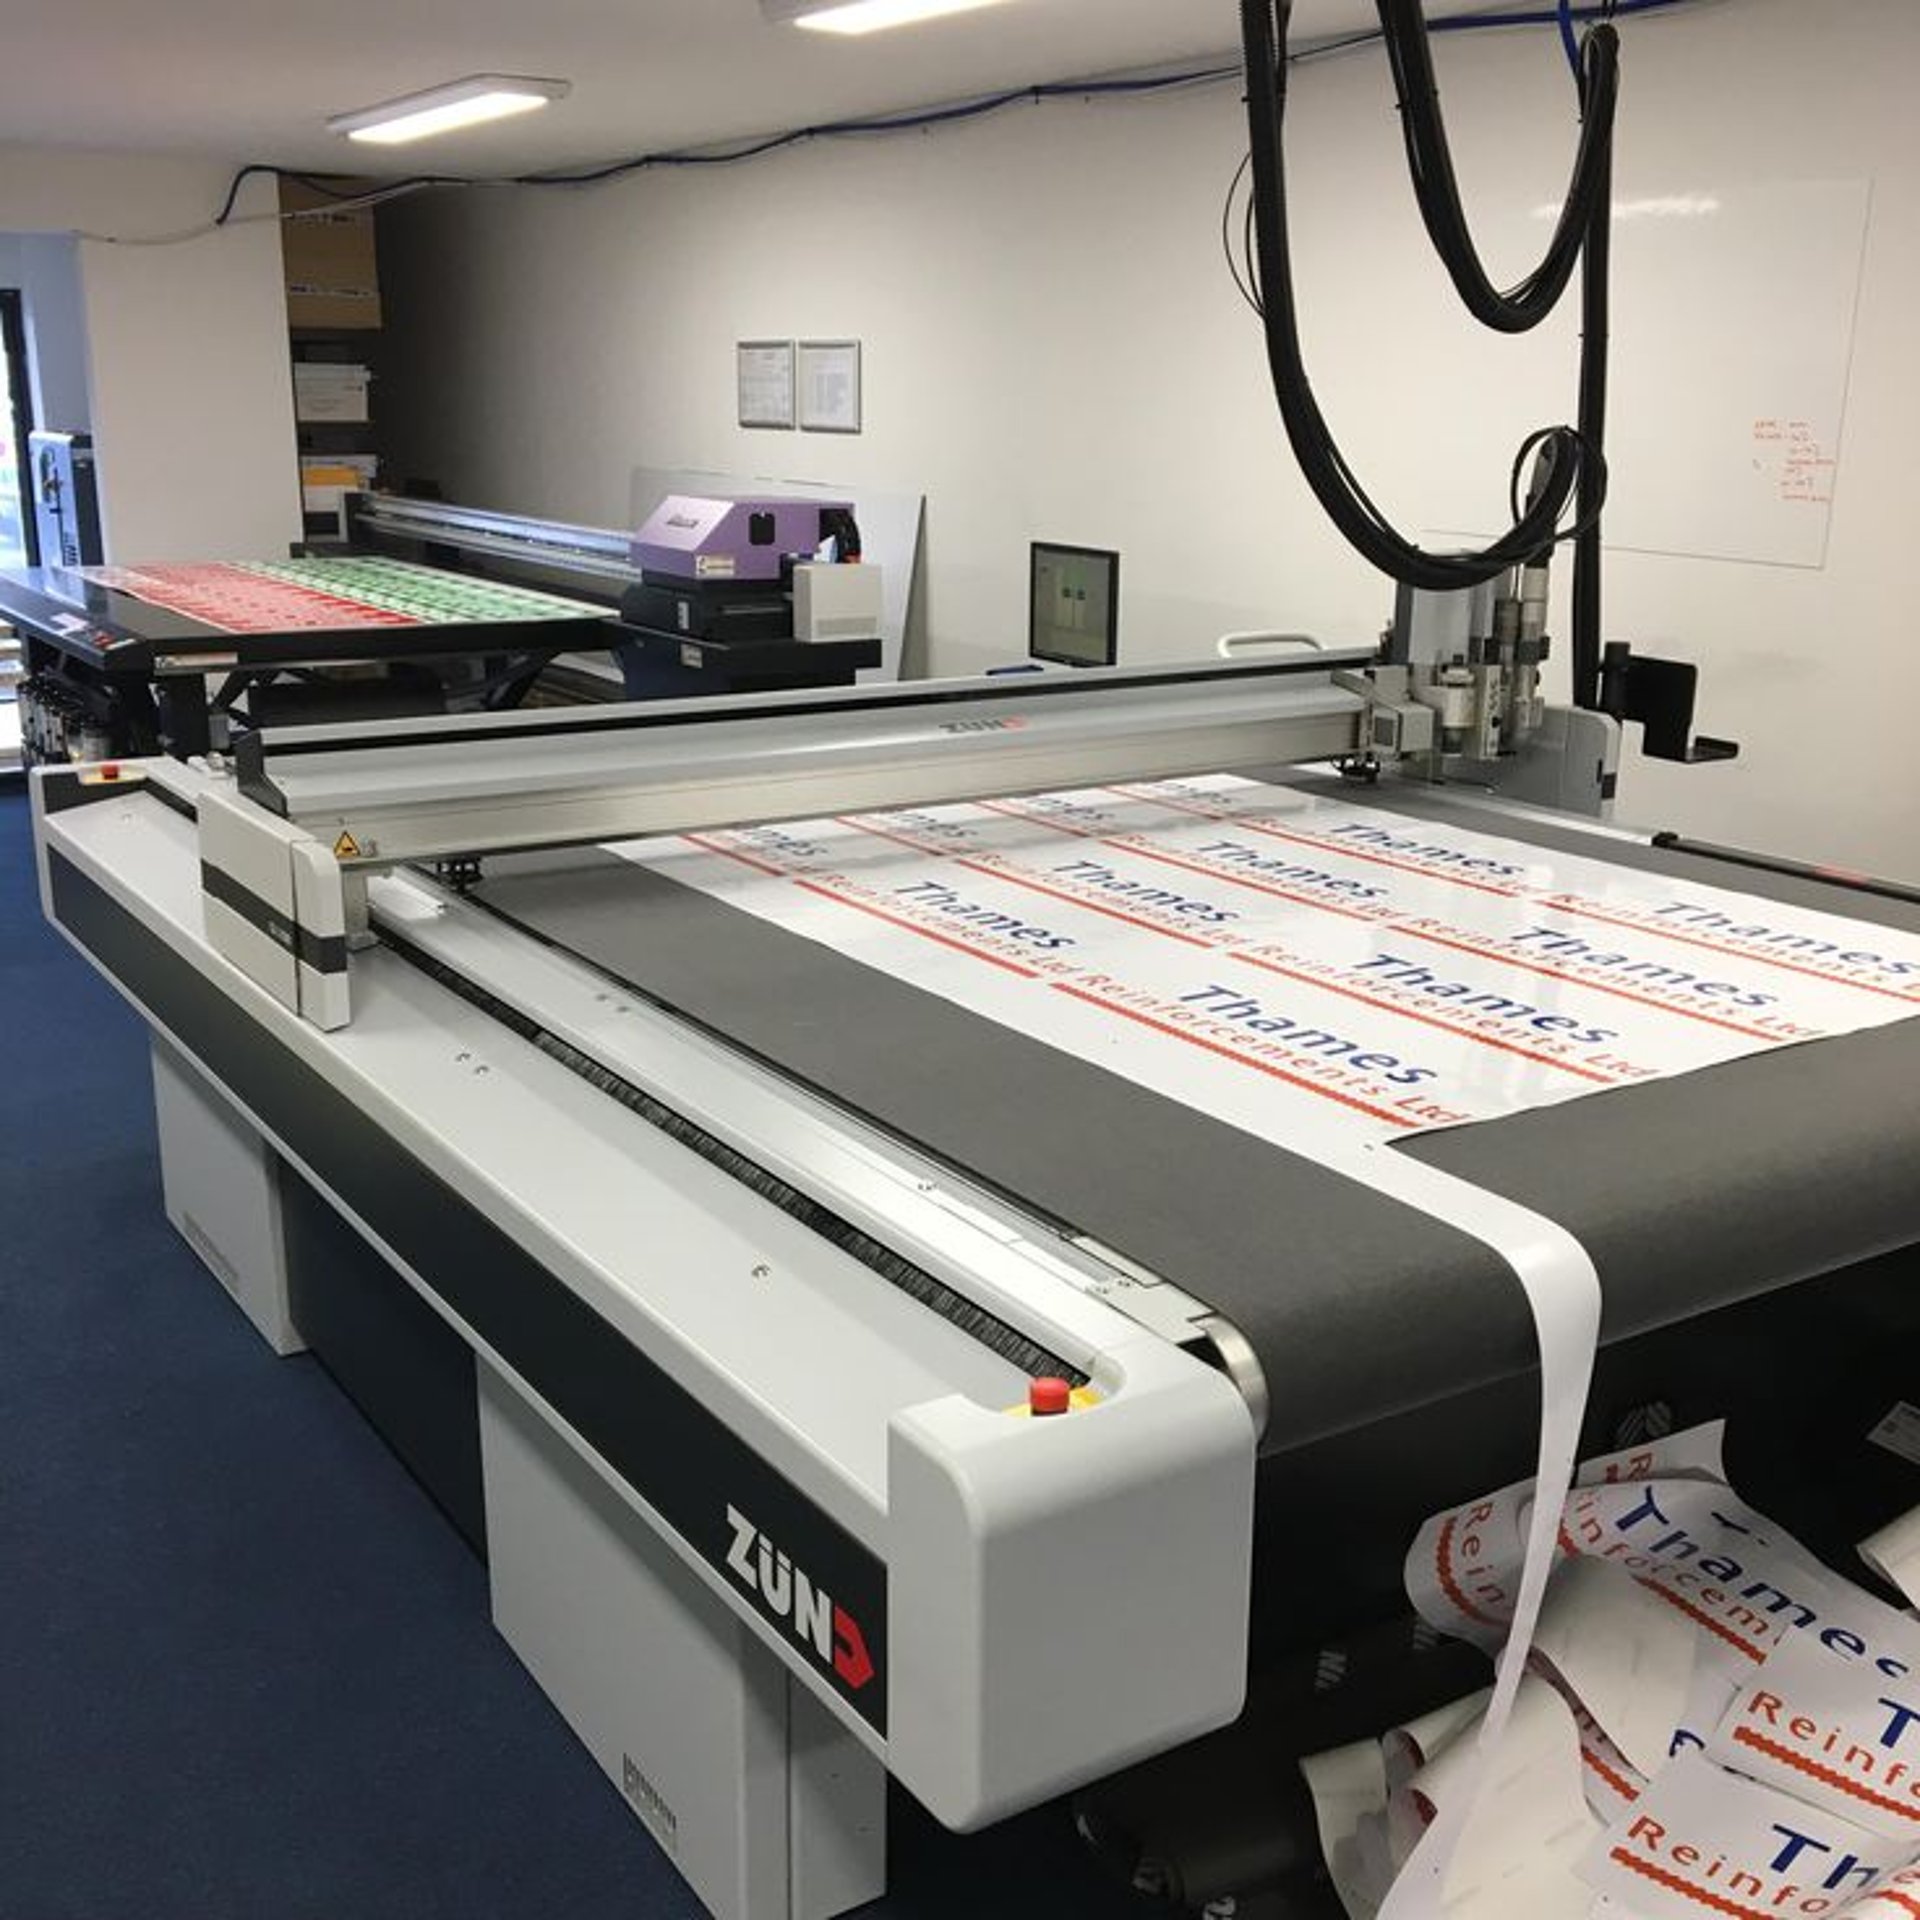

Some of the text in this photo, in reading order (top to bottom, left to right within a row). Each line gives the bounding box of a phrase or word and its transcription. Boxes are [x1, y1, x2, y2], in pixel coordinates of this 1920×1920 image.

[1196, 839, 1390, 898] Thames
[1329, 822, 1526, 875] Thames
[894, 880, 1076, 949] Thames
[1052, 859, 1241, 922] Thames
[1509, 924, 1781, 1009] Thames
[1651, 901, 1920, 976] Thames
[1353, 952, 1621, 1045] Thames
[1178, 983, 1438, 1085] Thames
[1393, 1094, 1472, 1125] Ltd
